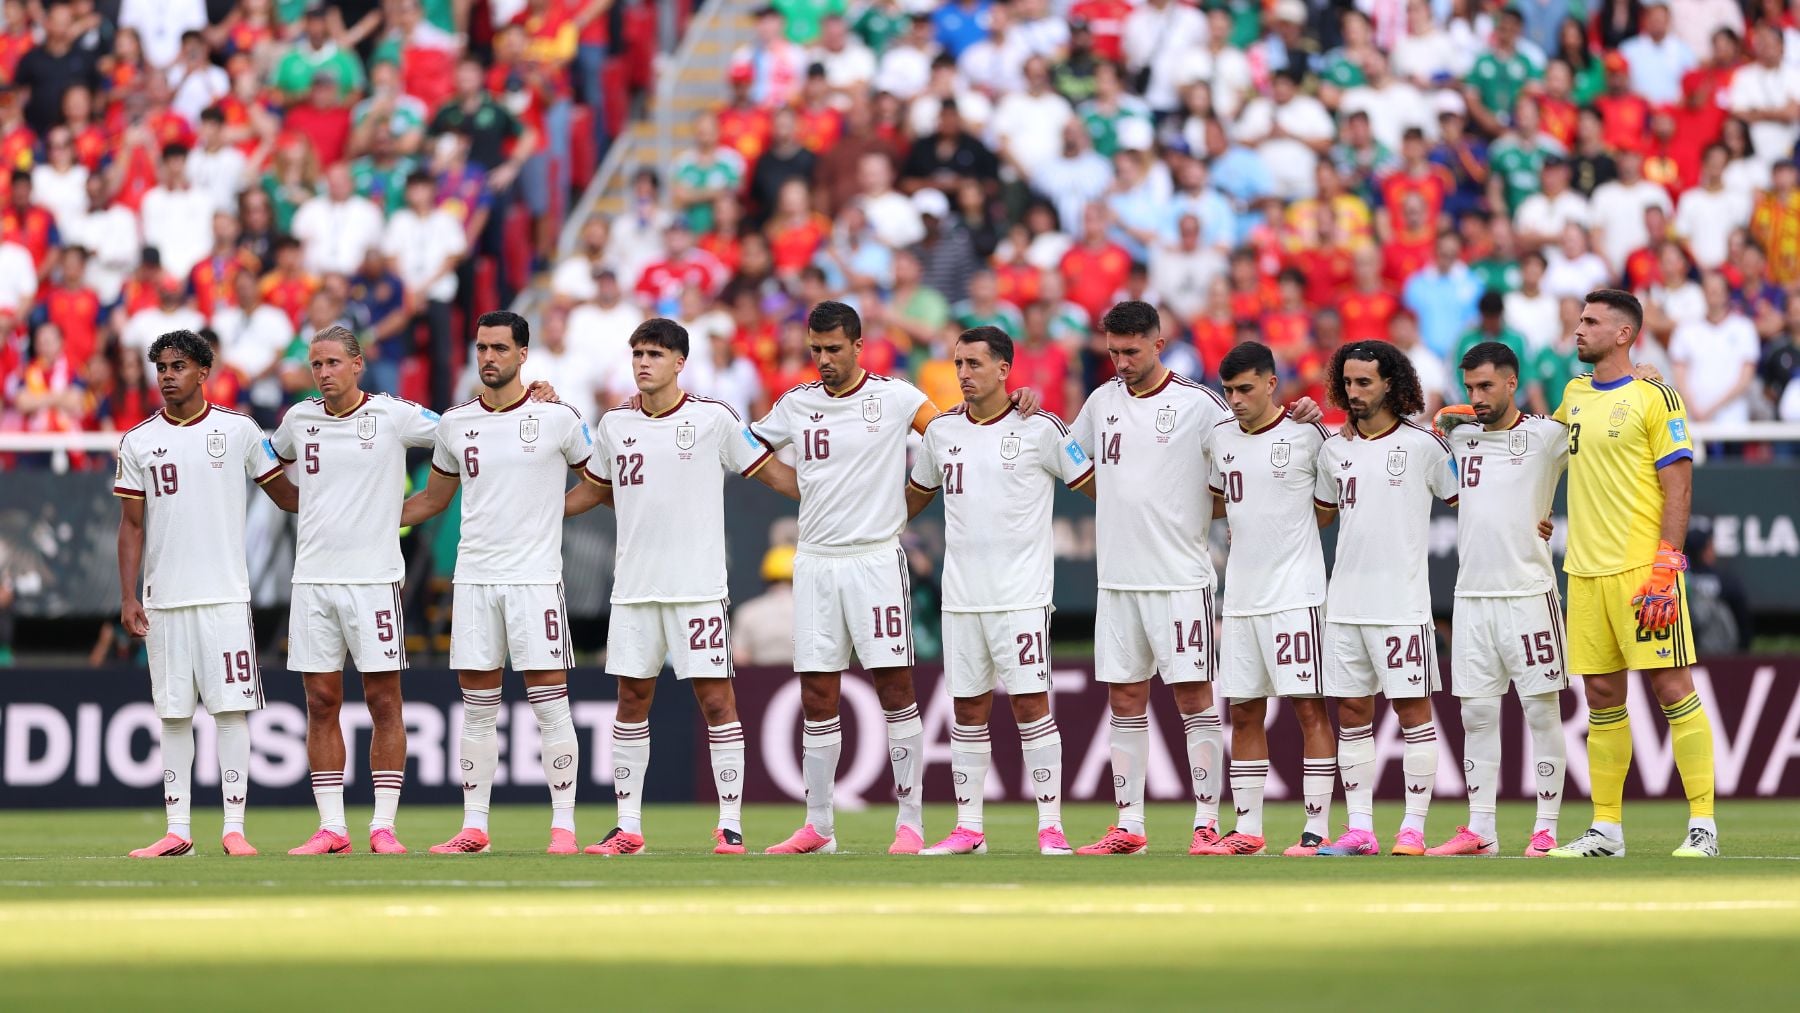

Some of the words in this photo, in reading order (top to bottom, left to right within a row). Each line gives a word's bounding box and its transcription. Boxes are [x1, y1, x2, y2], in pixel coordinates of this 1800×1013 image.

[803, 429, 830, 462] 16
[1101, 432, 1122, 466] 14
[1568, 422, 1581, 455] 3
[304, 443, 320, 475] 5
[463, 447, 480, 479] 6
[615, 454, 644, 487] 22
[1460, 455, 1484, 489] 15
[149, 464, 179, 497] 19
[943, 463, 964, 495] 21
[375, 610, 394, 643] 5
[544, 609, 559, 641] 6
[689, 617, 724, 650] 22
[873, 606, 902, 639] 16
[1174, 620, 1204, 654] 14
[1017, 632, 1045, 667] 21
[1275, 632, 1311, 666] 20
[1386, 635, 1422, 669] 24
[1520, 631, 1554, 668] 15
[223, 651, 251, 684] 19
